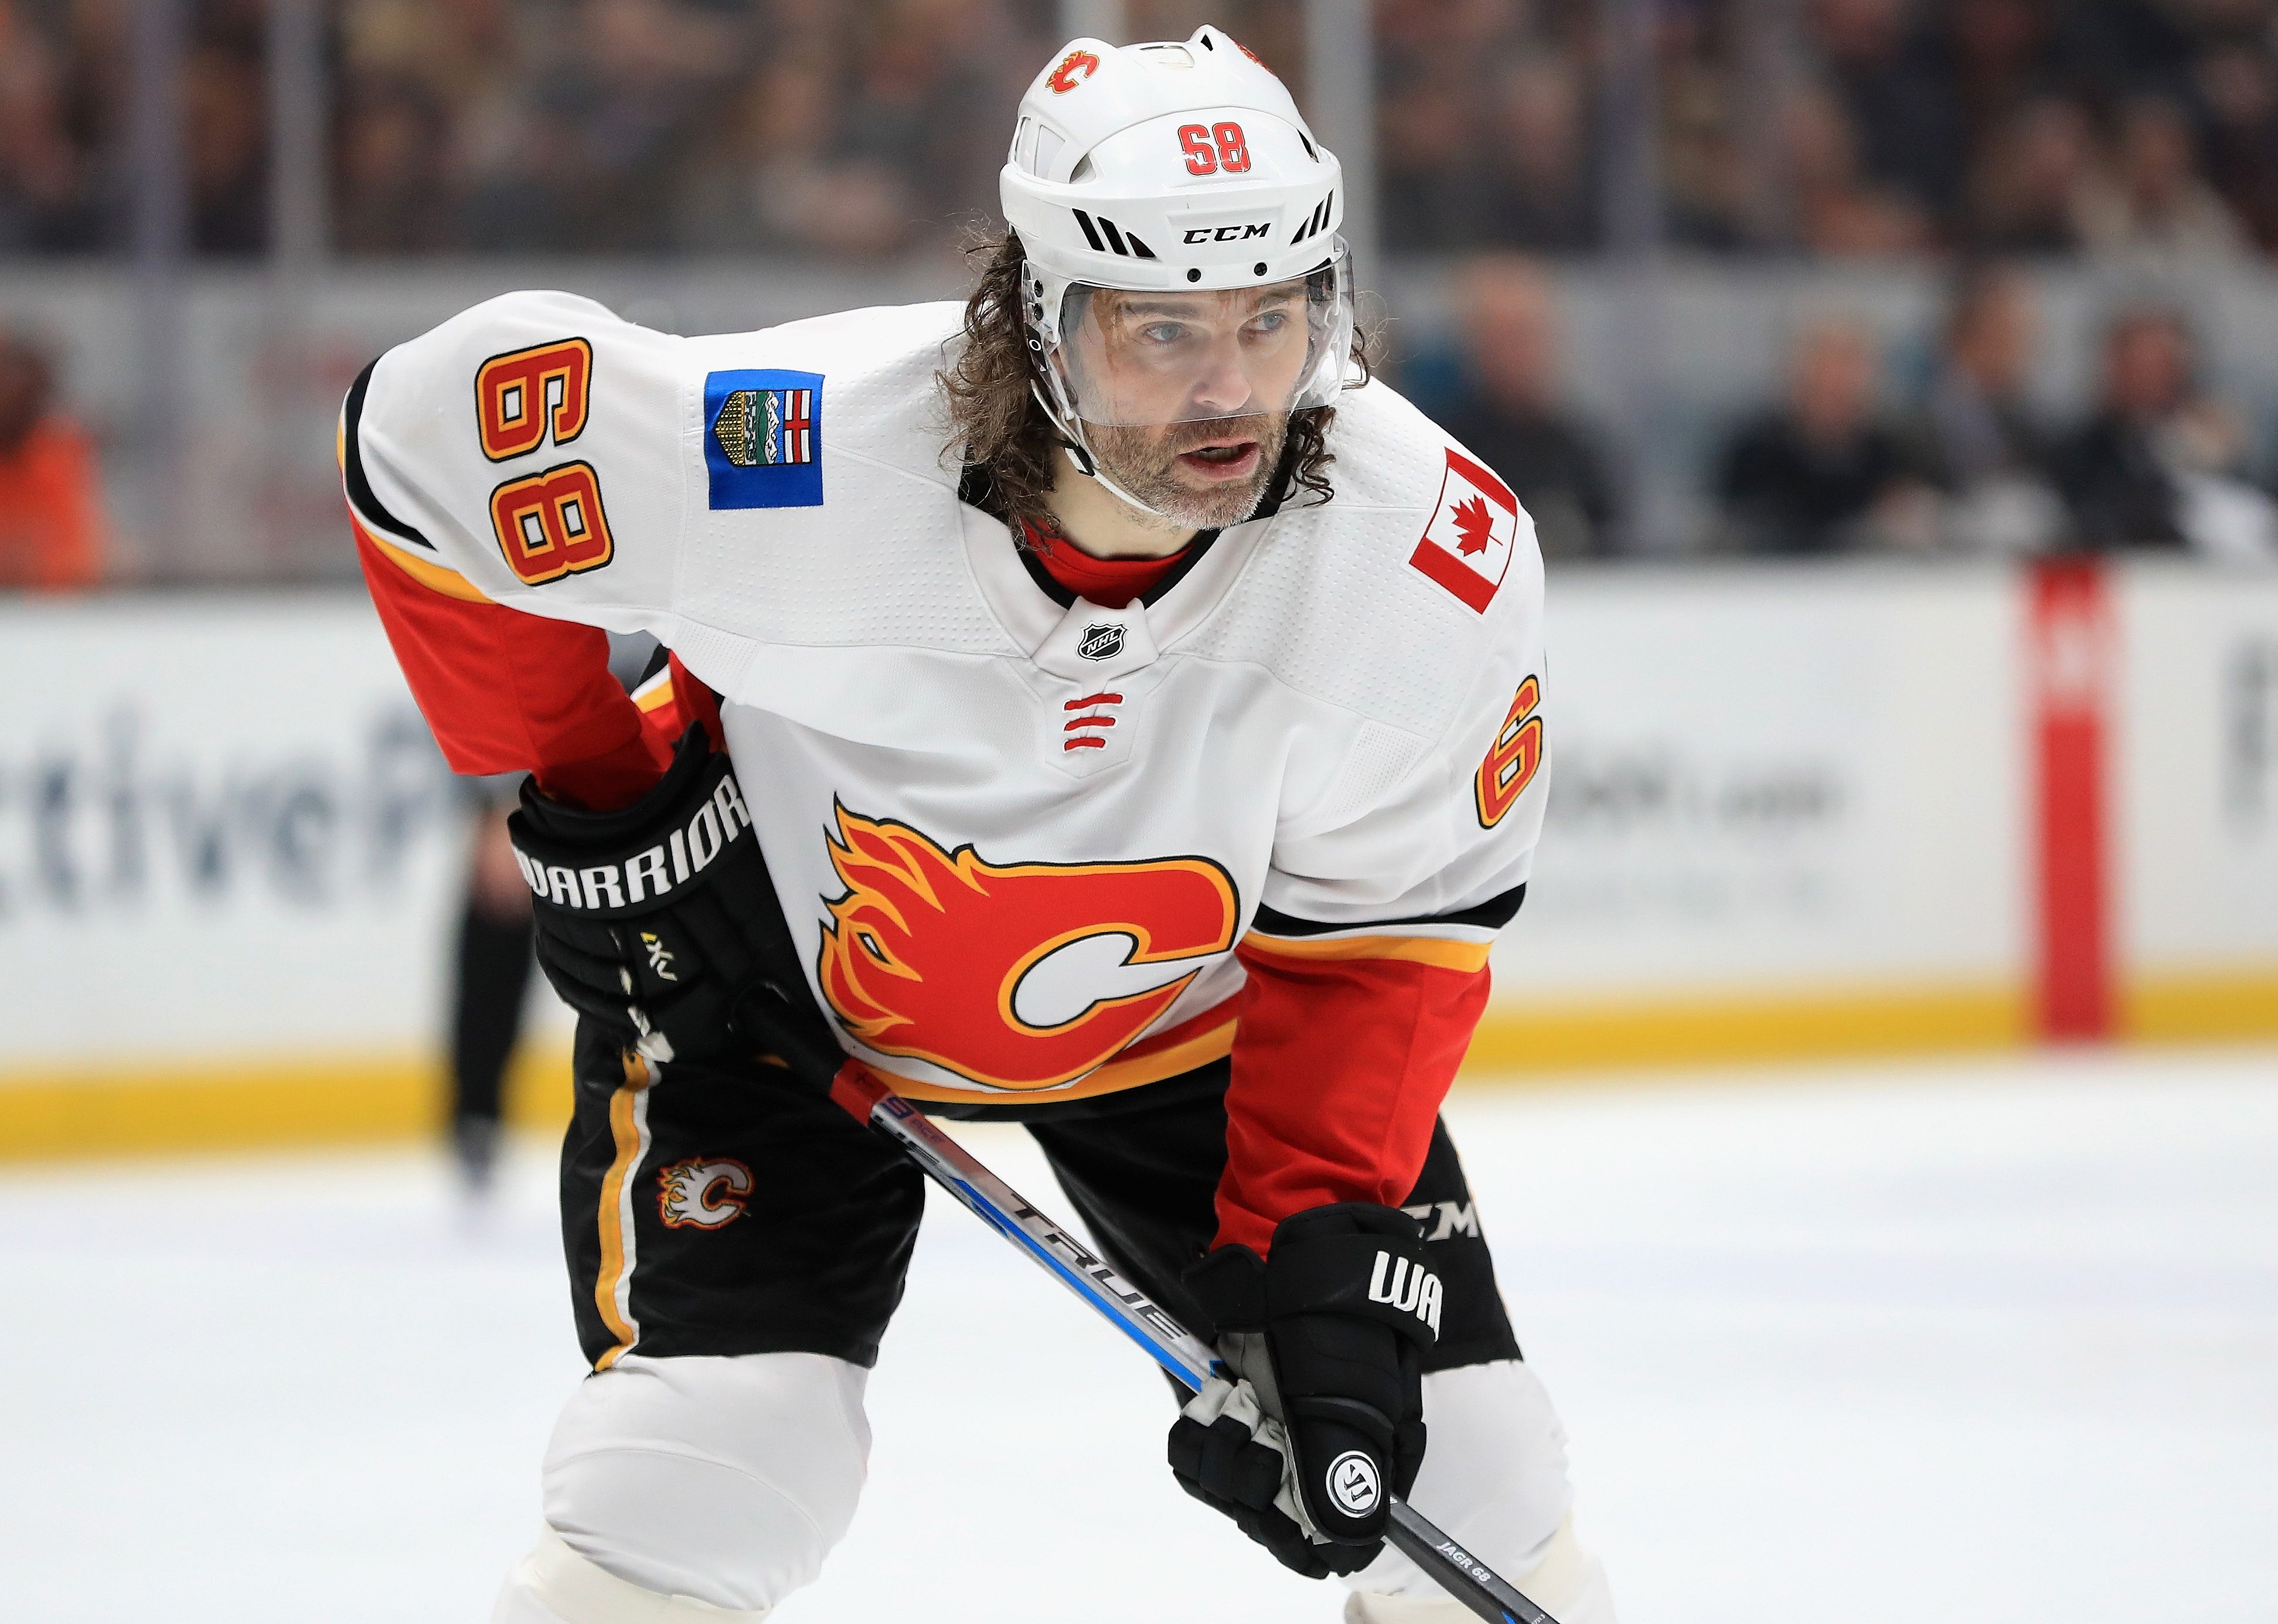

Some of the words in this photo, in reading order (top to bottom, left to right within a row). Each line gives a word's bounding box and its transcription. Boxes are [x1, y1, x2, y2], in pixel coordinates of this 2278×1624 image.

[1178, 121, 1251, 176] 68
[1183, 223, 1271, 244] CCM
[475, 336, 615, 587] 68
[1086, 631, 1119, 654] NHL
[512, 774, 751, 910] WARRIOR
[1011, 1192, 1189, 1342] TRUE
[1435, 1542, 1473, 1569] JAGR
[1472, 1567, 1492, 1582] 68
